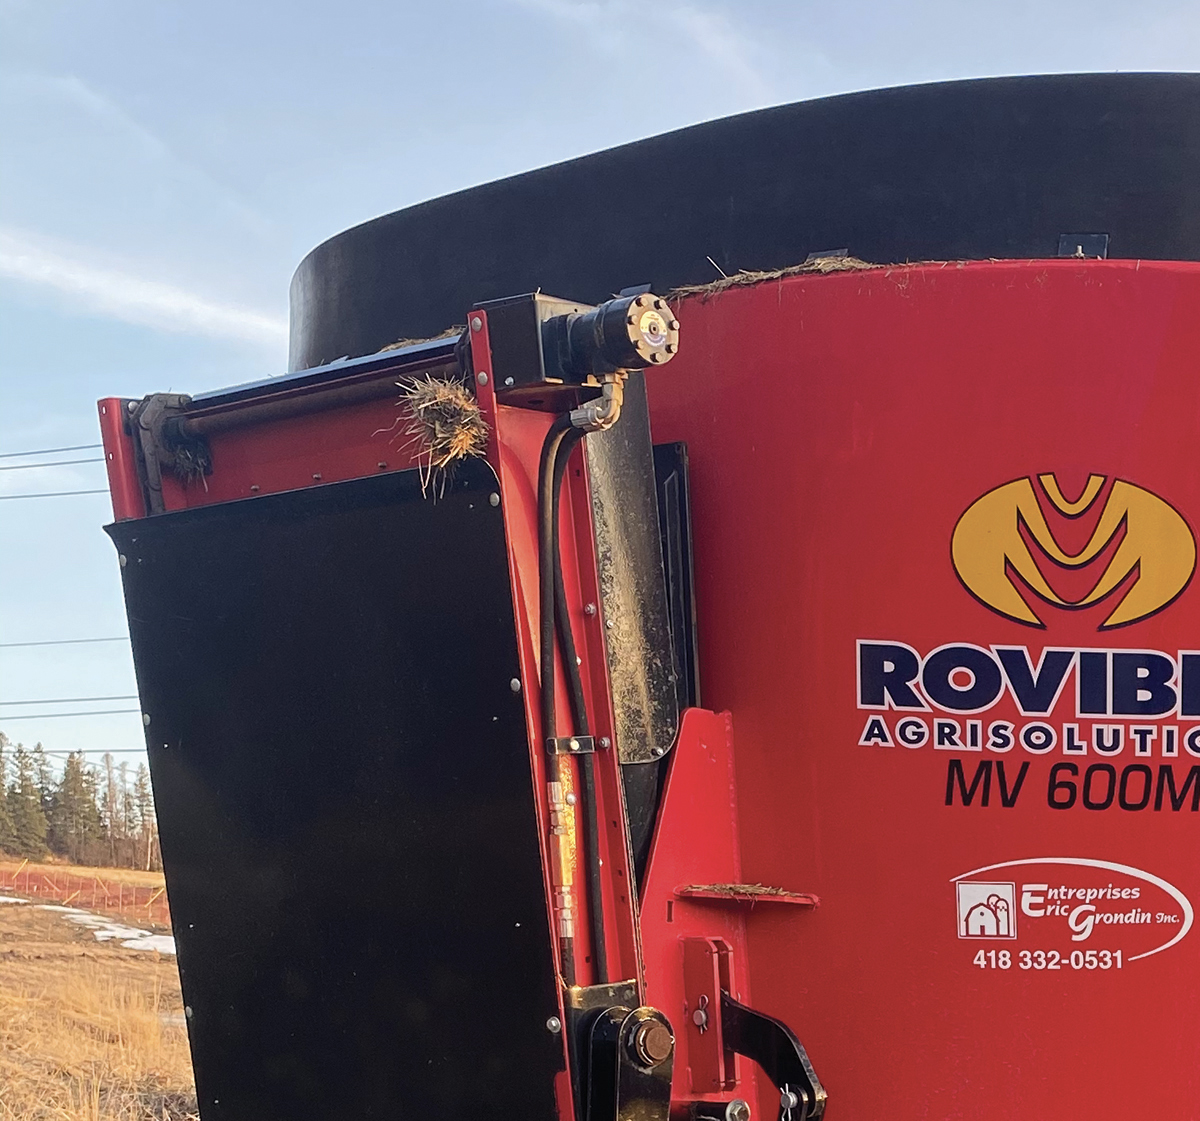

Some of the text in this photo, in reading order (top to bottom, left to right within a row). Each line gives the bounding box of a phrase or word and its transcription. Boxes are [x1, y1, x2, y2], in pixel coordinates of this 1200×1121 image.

[944, 759, 1030, 808] MV
[1021, 883, 1141, 906] Entreprises
[1021, 891, 1180, 942] Eric Grondin Inc.
[973, 949, 1123, 970] 418 332-0531
